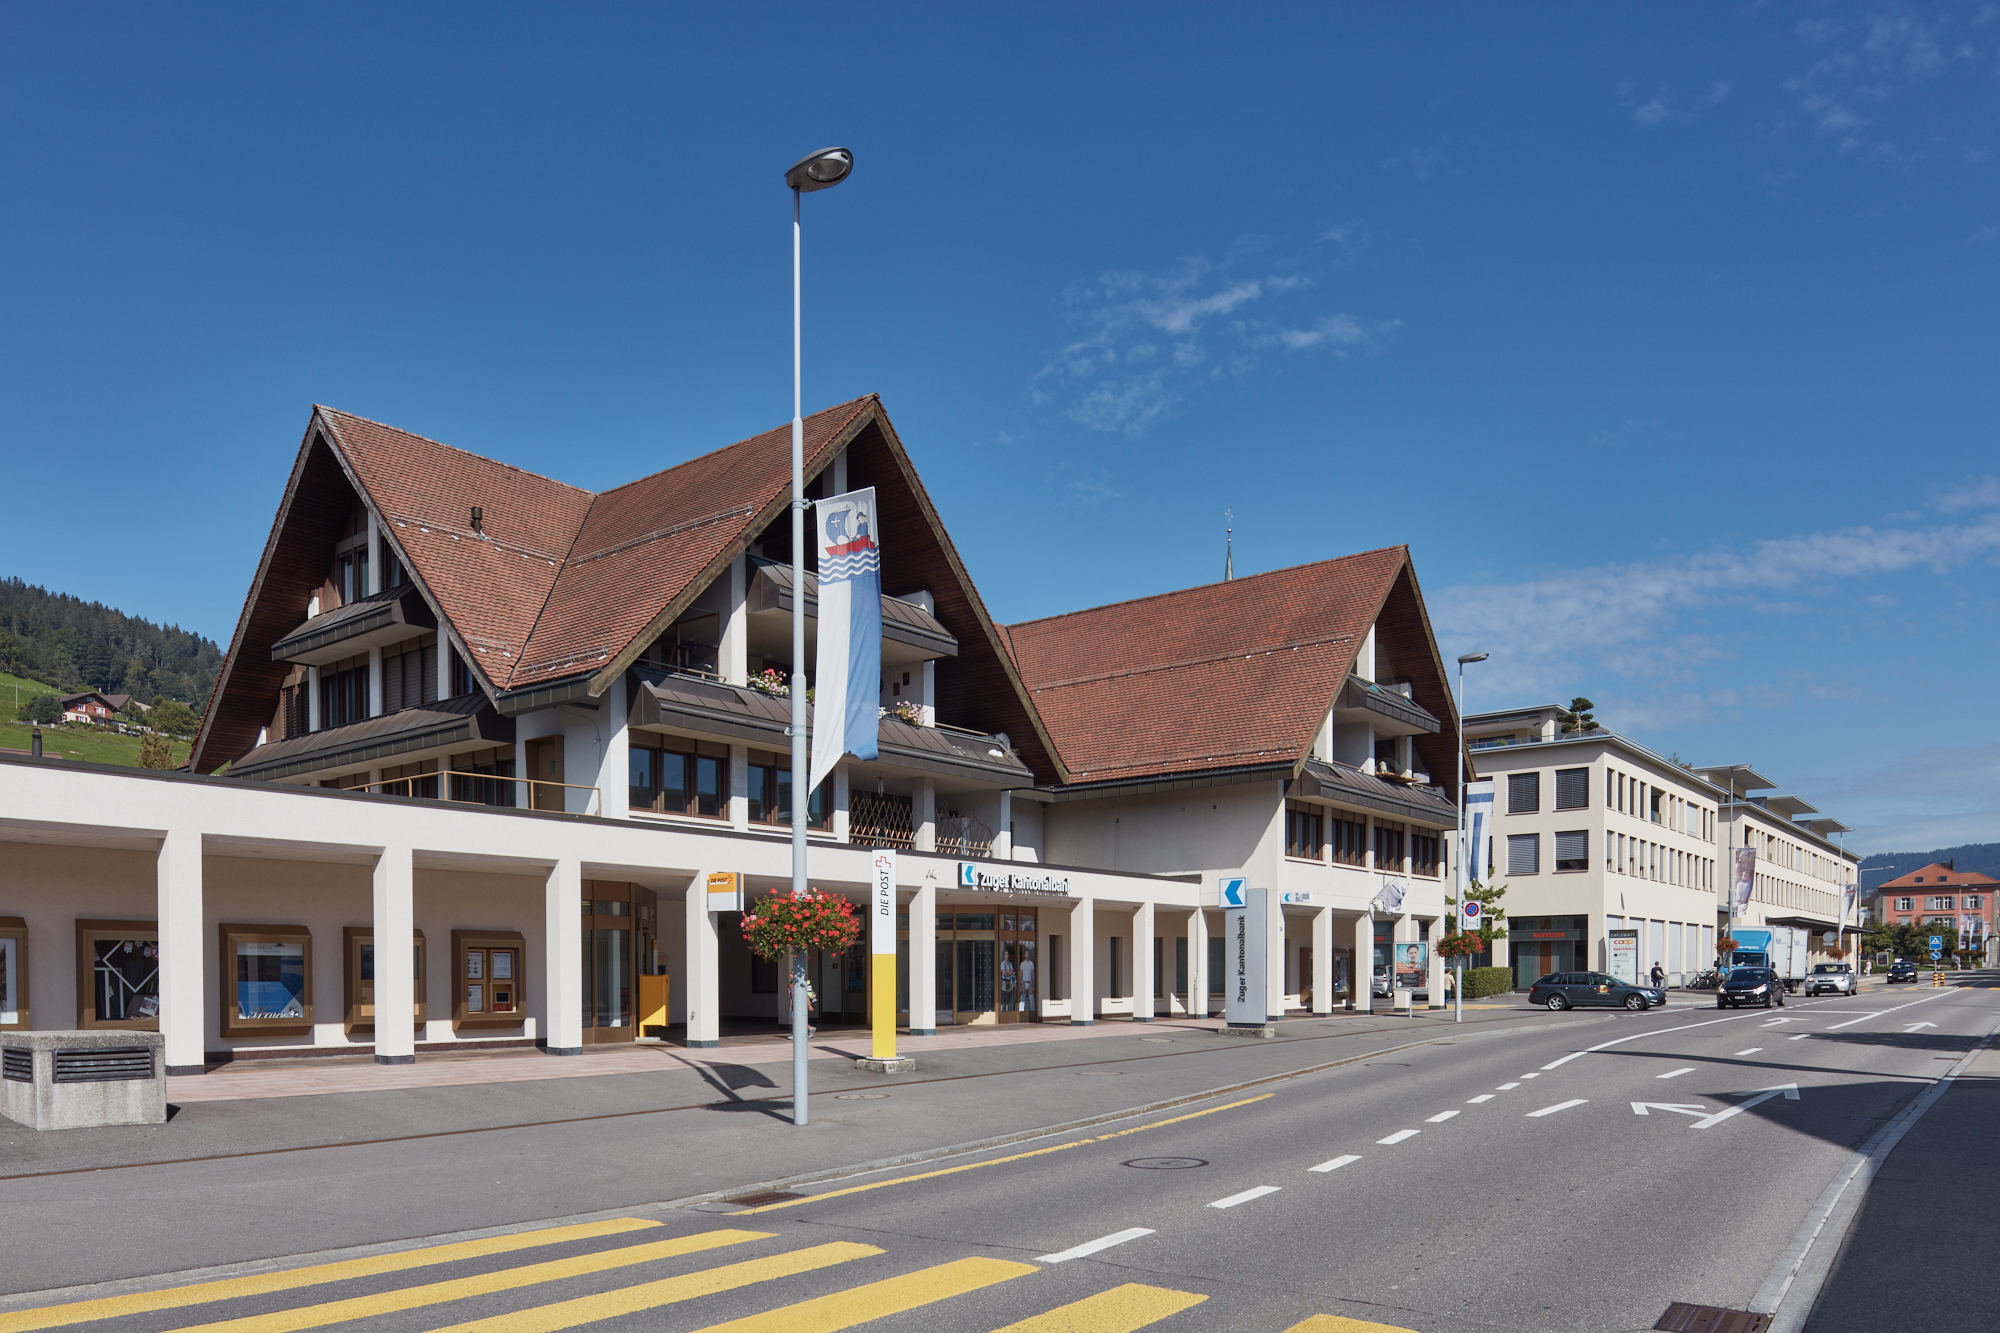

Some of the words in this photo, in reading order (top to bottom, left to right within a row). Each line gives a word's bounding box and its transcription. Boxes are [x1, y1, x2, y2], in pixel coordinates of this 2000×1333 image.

[880, 869, 889, 897] POST
[979, 873, 1009, 892] Zuger
[1011, 874, 1072, 893] Kantonalbank
[880, 898, 889, 916] DIE
[1237, 915, 1245, 976] Kantonalbank
[1237, 977, 1247, 1003] Zuger
